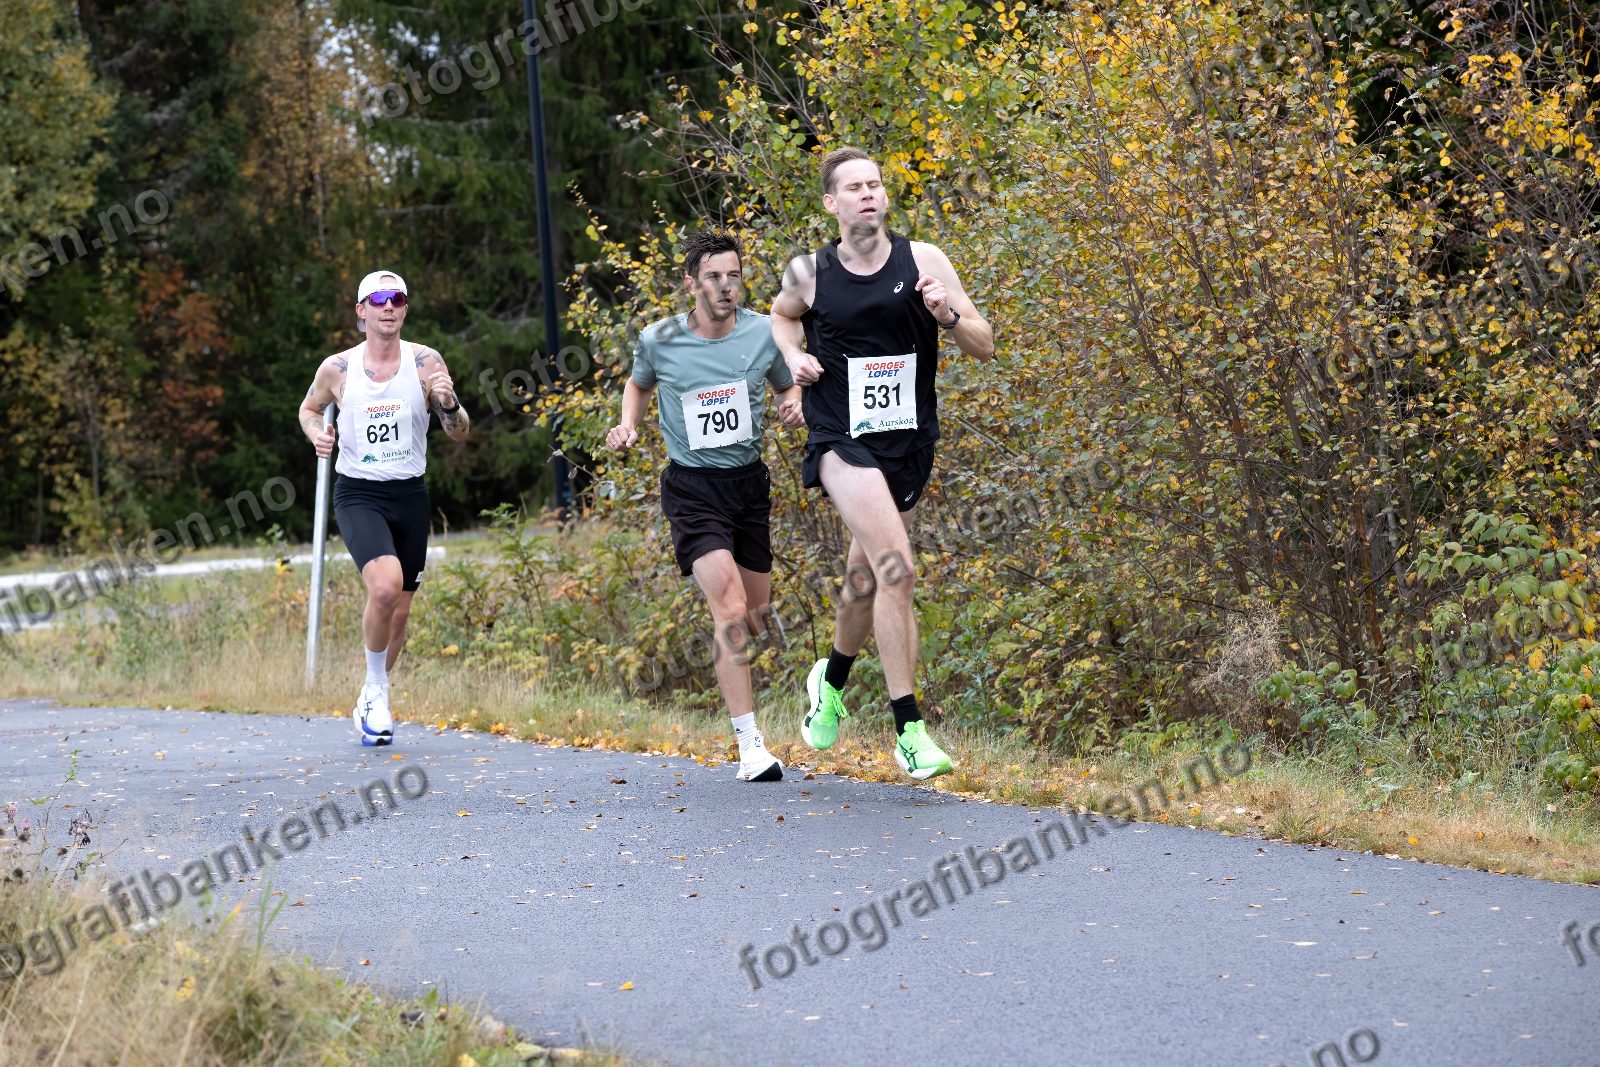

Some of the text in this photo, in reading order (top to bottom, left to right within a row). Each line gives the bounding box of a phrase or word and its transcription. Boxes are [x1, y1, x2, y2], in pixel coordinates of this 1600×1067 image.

[865, 361, 905, 370] NORGES
[868, 369, 899, 378] LØPET
[697, 388, 735, 400] NORGES
[864, 382, 901, 409] 531
[702, 396, 731, 406] LØPET
[366, 404, 401, 413] NORGES
[370, 411, 396, 419] LØPET
[698, 408, 739, 436] 790
[879, 417, 914, 427] Aurskog
[367, 422, 399, 444] 621
[382, 449, 411, 458] Aurskog
